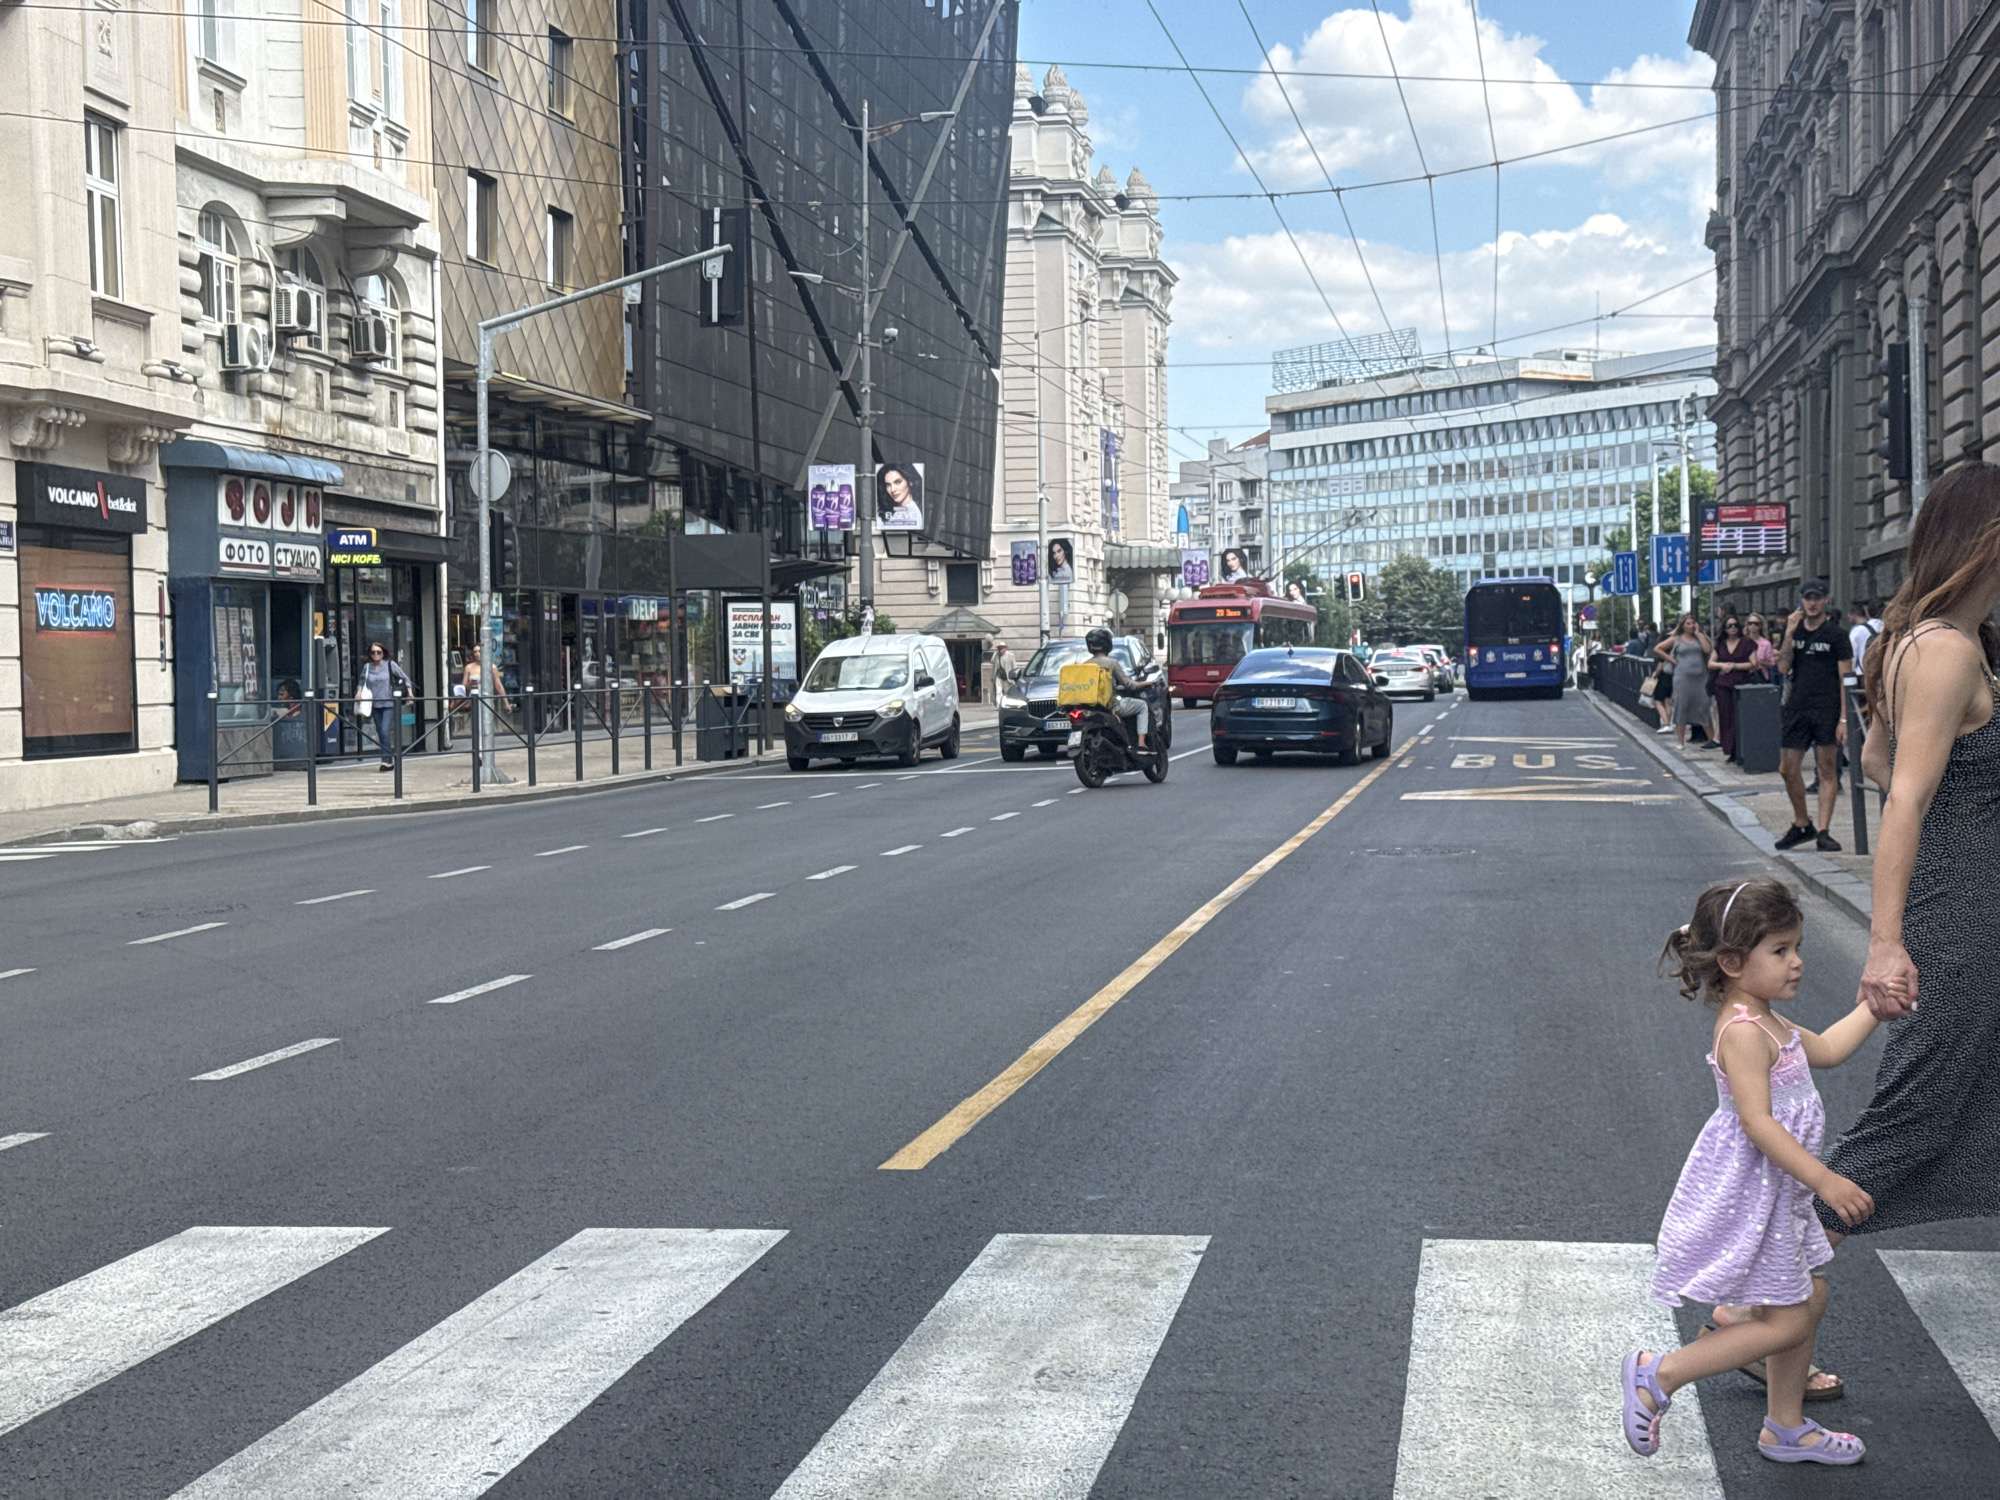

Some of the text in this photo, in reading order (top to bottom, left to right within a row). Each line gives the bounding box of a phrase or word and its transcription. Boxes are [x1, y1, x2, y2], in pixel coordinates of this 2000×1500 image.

[48, 486, 98, 508] VOLCANO
[339, 534, 367, 545] ATM
[225, 543, 317, 568] ФОТО СТУДИО
[35, 592, 116, 628] VOLCANO
[470, 591, 502, 616] DFI
[633, 600, 658, 620] DELFI
[732, 614, 781, 622] БЕСПЛААН
[732, 622, 792, 630] ЈАВНИ ПЕВОЗ
[1451, 754, 1619, 769] BUS
